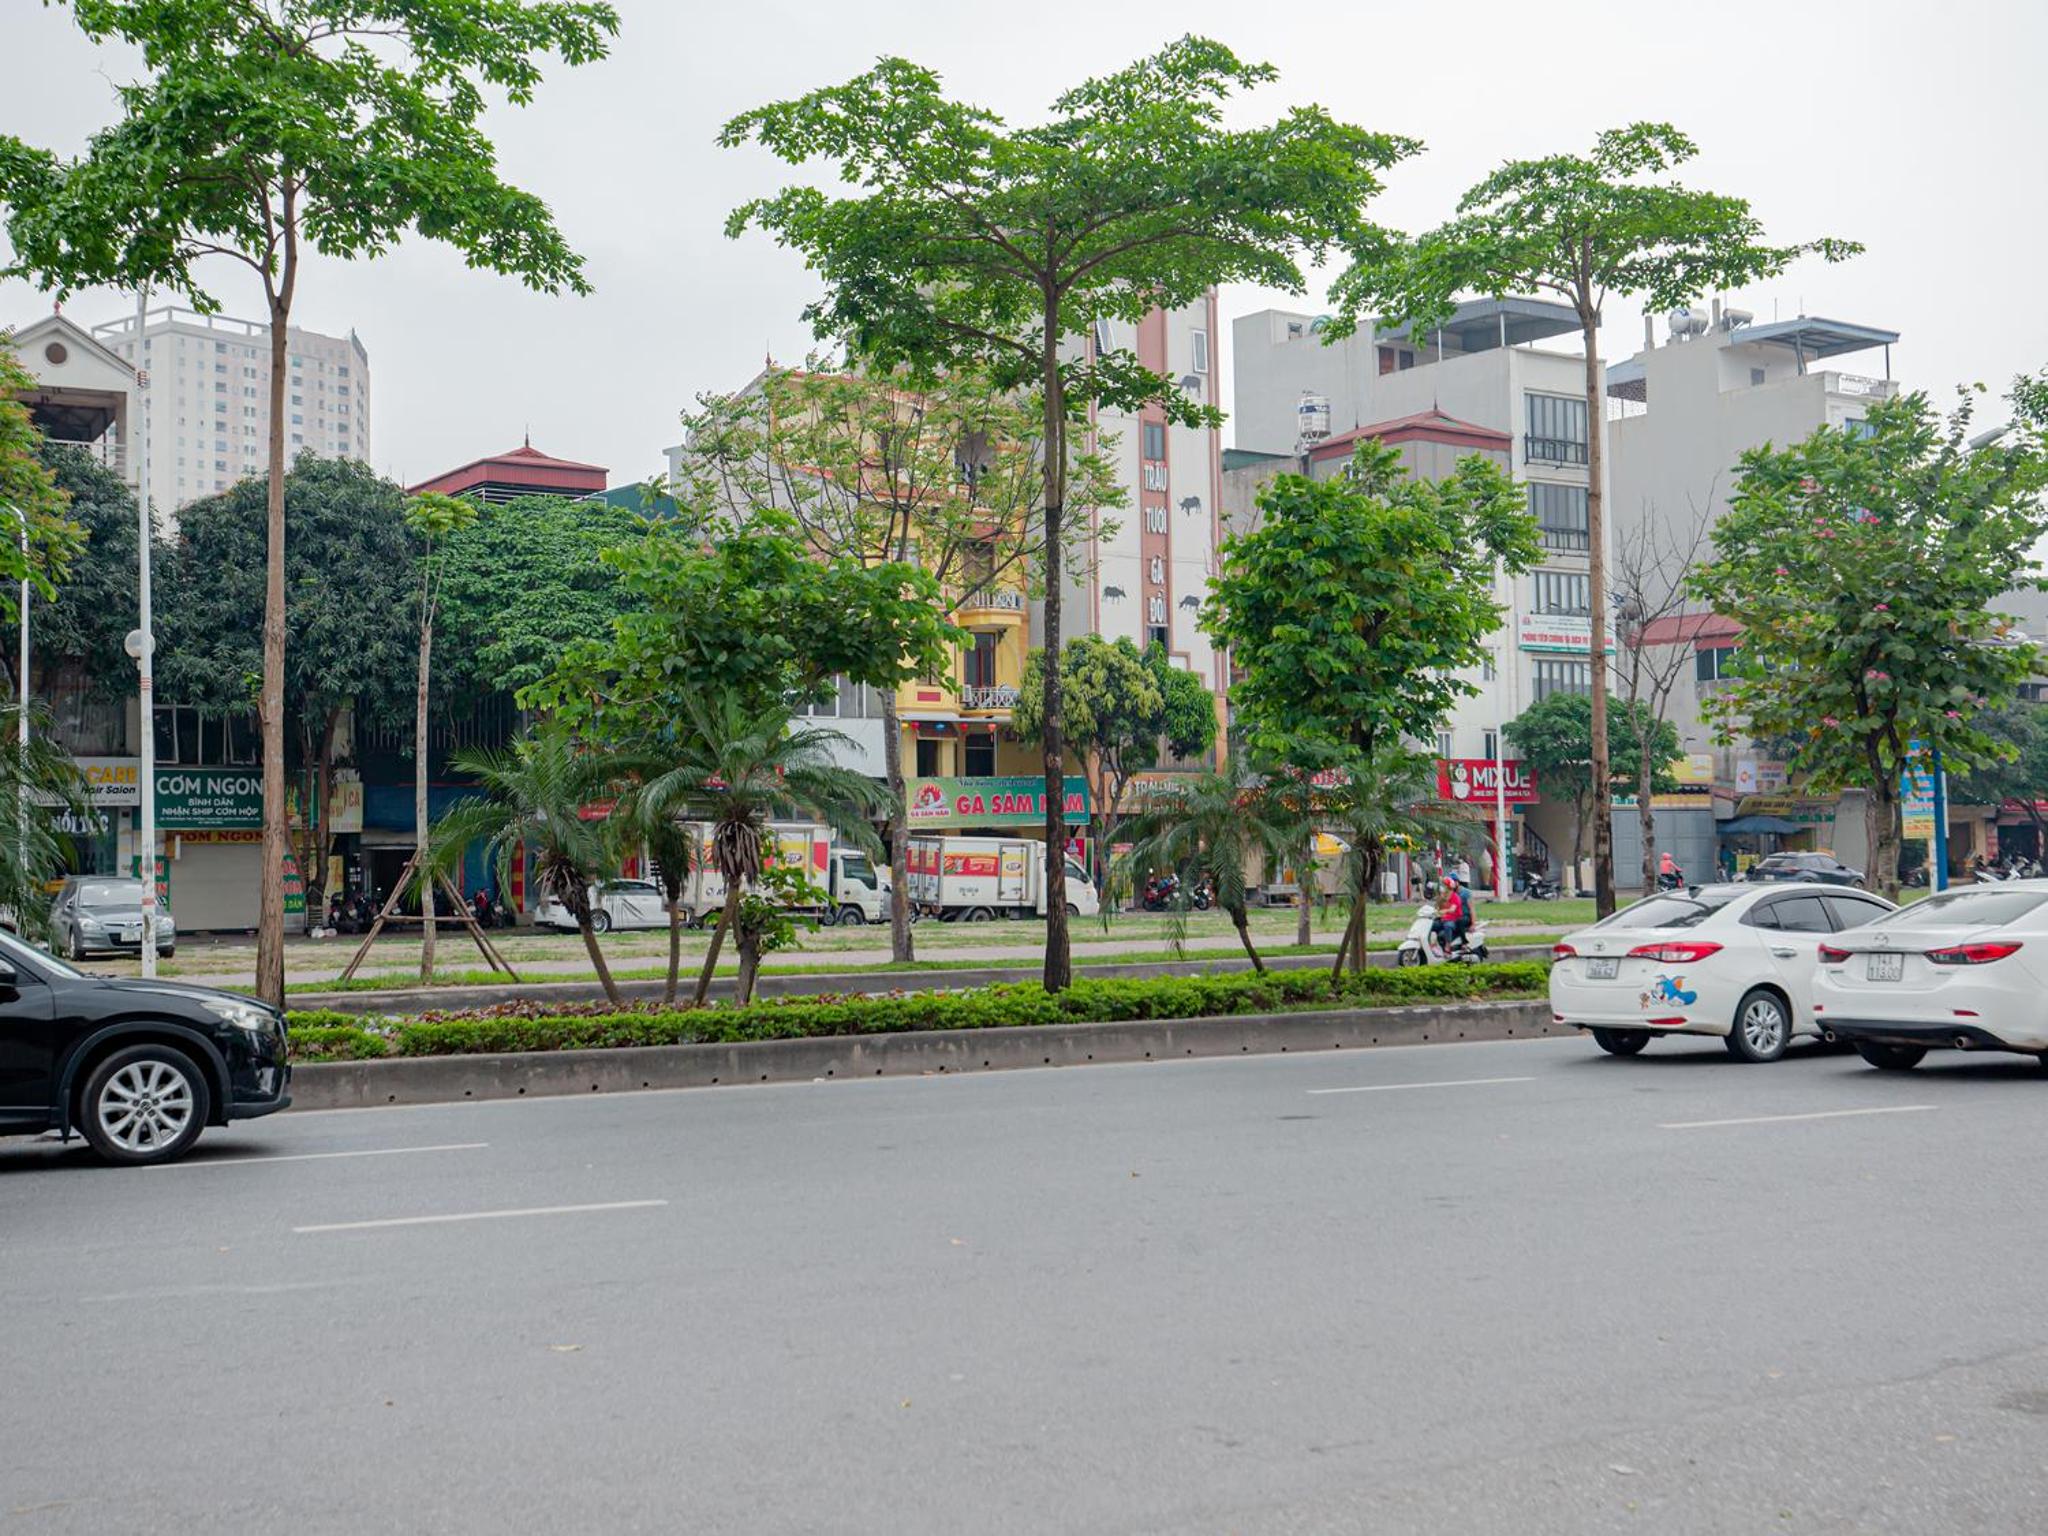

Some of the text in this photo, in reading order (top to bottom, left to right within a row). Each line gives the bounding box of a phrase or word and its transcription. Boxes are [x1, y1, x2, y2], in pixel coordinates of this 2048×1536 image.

[86, 766, 137, 784] CARE
[105, 786, 136, 794] Salon
[156, 774, 264, 795] CƠM NGON
[188, 797, 234, 806] BÌNH DÂN
[956, 791, 985, 815] GÀ
[991, 791, 1033, 814] SÂM
[162, 805, 259, 816] NHẬN SHIP CƠM HỘP
